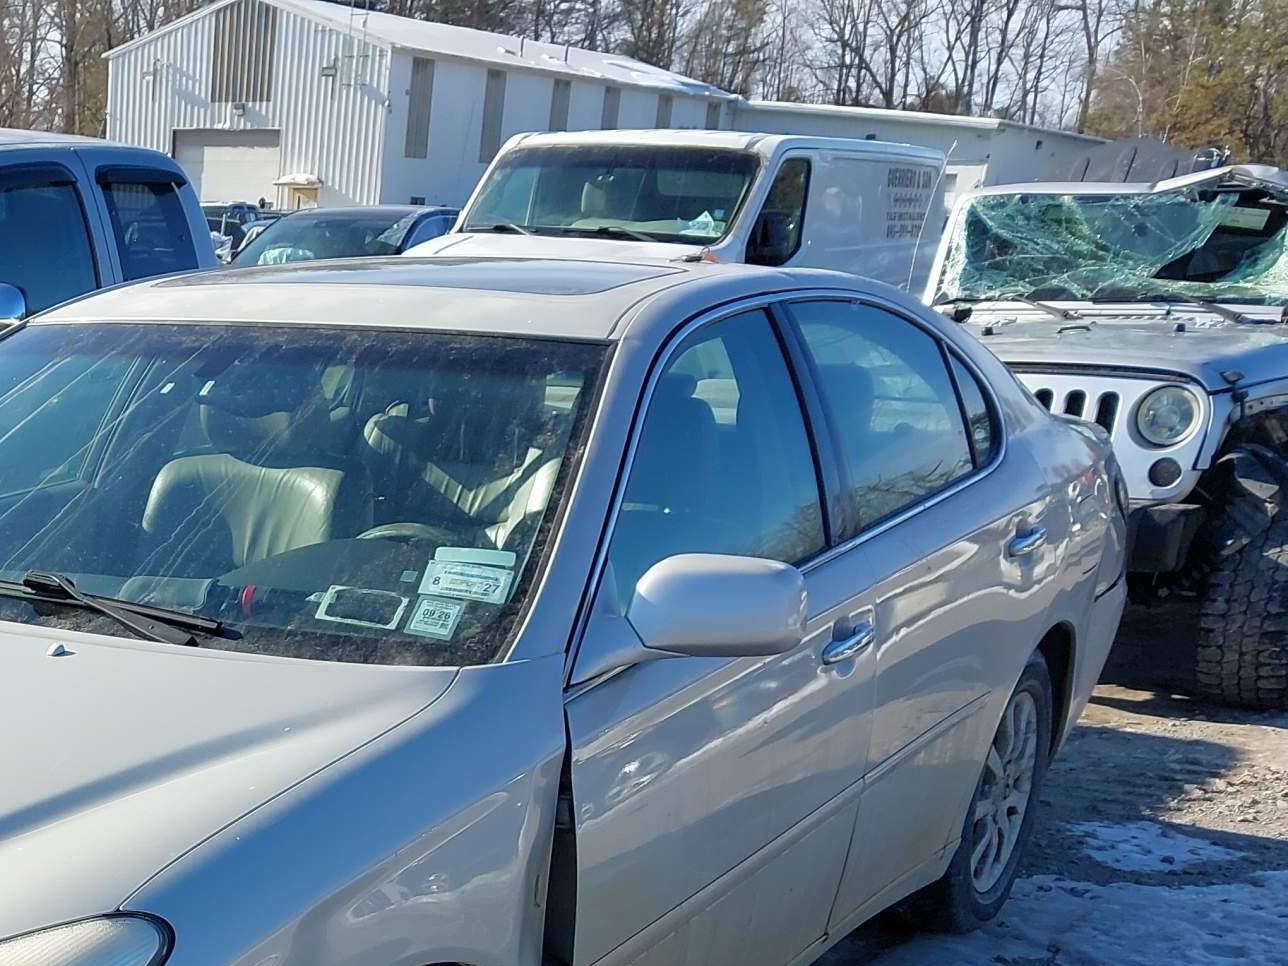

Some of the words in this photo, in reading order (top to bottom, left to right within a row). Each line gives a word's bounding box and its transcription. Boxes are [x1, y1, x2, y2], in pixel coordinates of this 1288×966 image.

[432, 576, 441, 585] 8
[483, 583, 500, 594] 27
[422, 608, 436, 617] 09
[438, 610, 451, 620] 26
